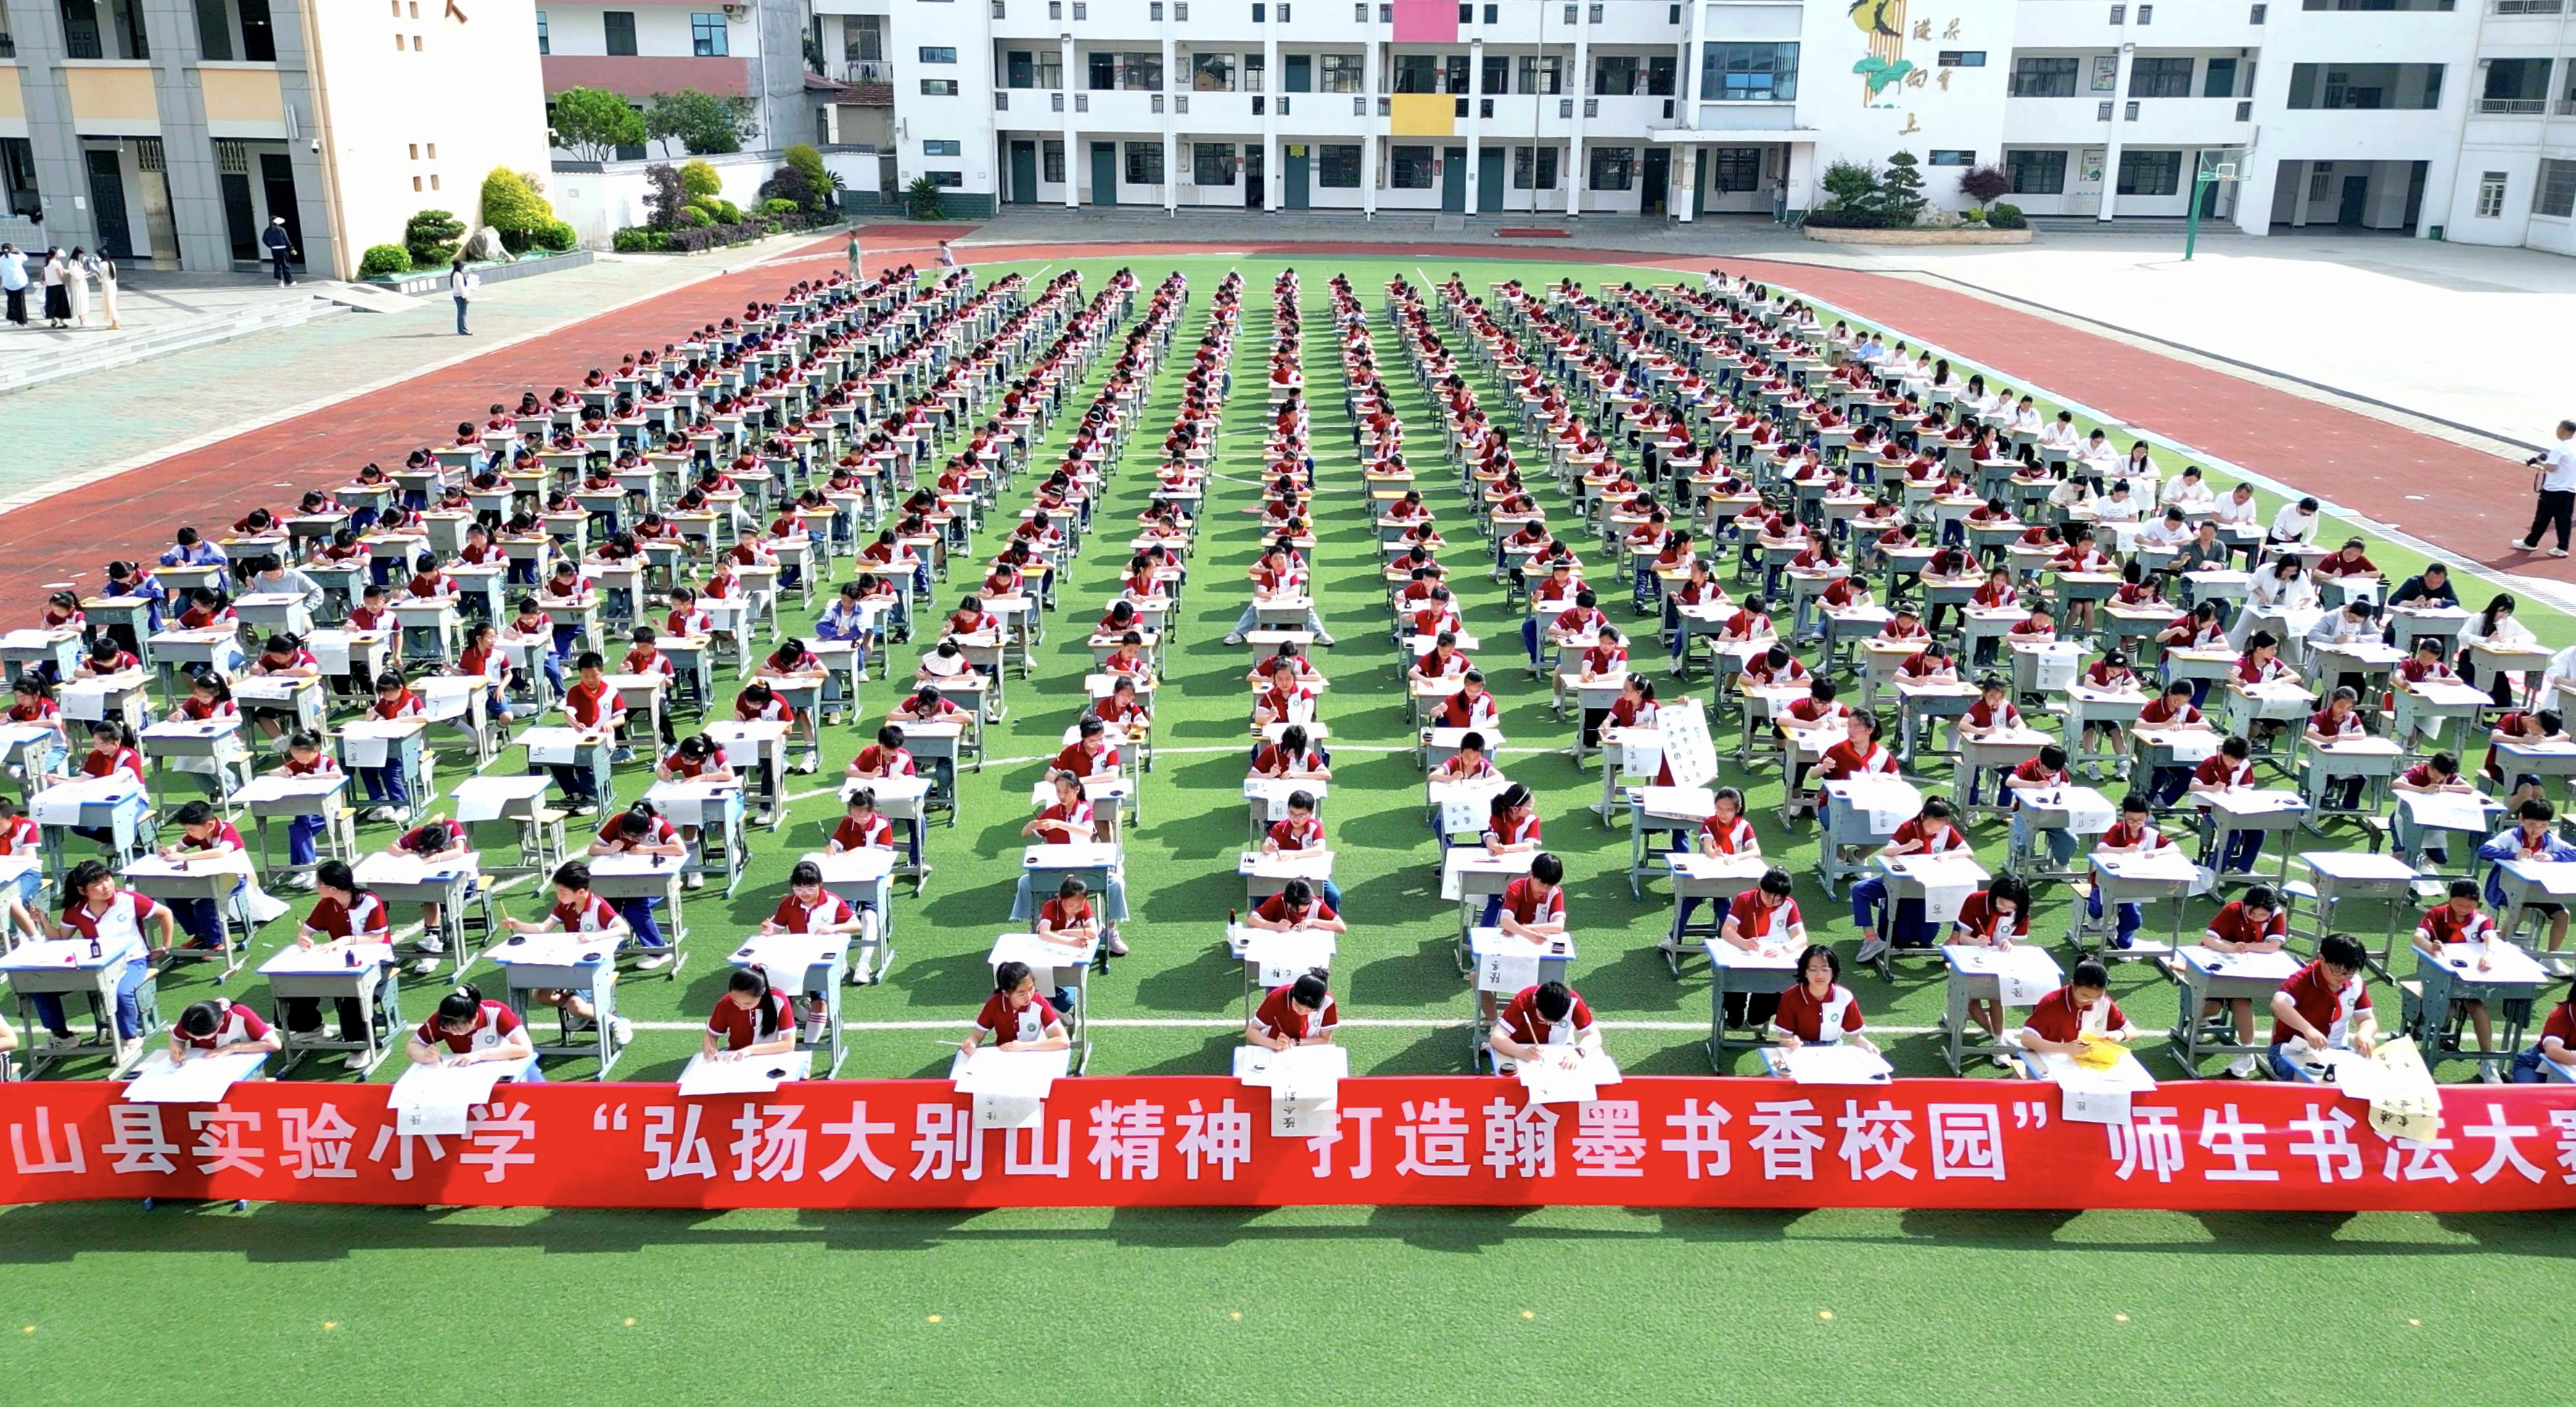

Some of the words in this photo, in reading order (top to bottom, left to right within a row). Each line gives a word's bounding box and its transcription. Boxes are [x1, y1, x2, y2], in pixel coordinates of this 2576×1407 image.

[10, 1102, 535, 1184] 山县实验小学
